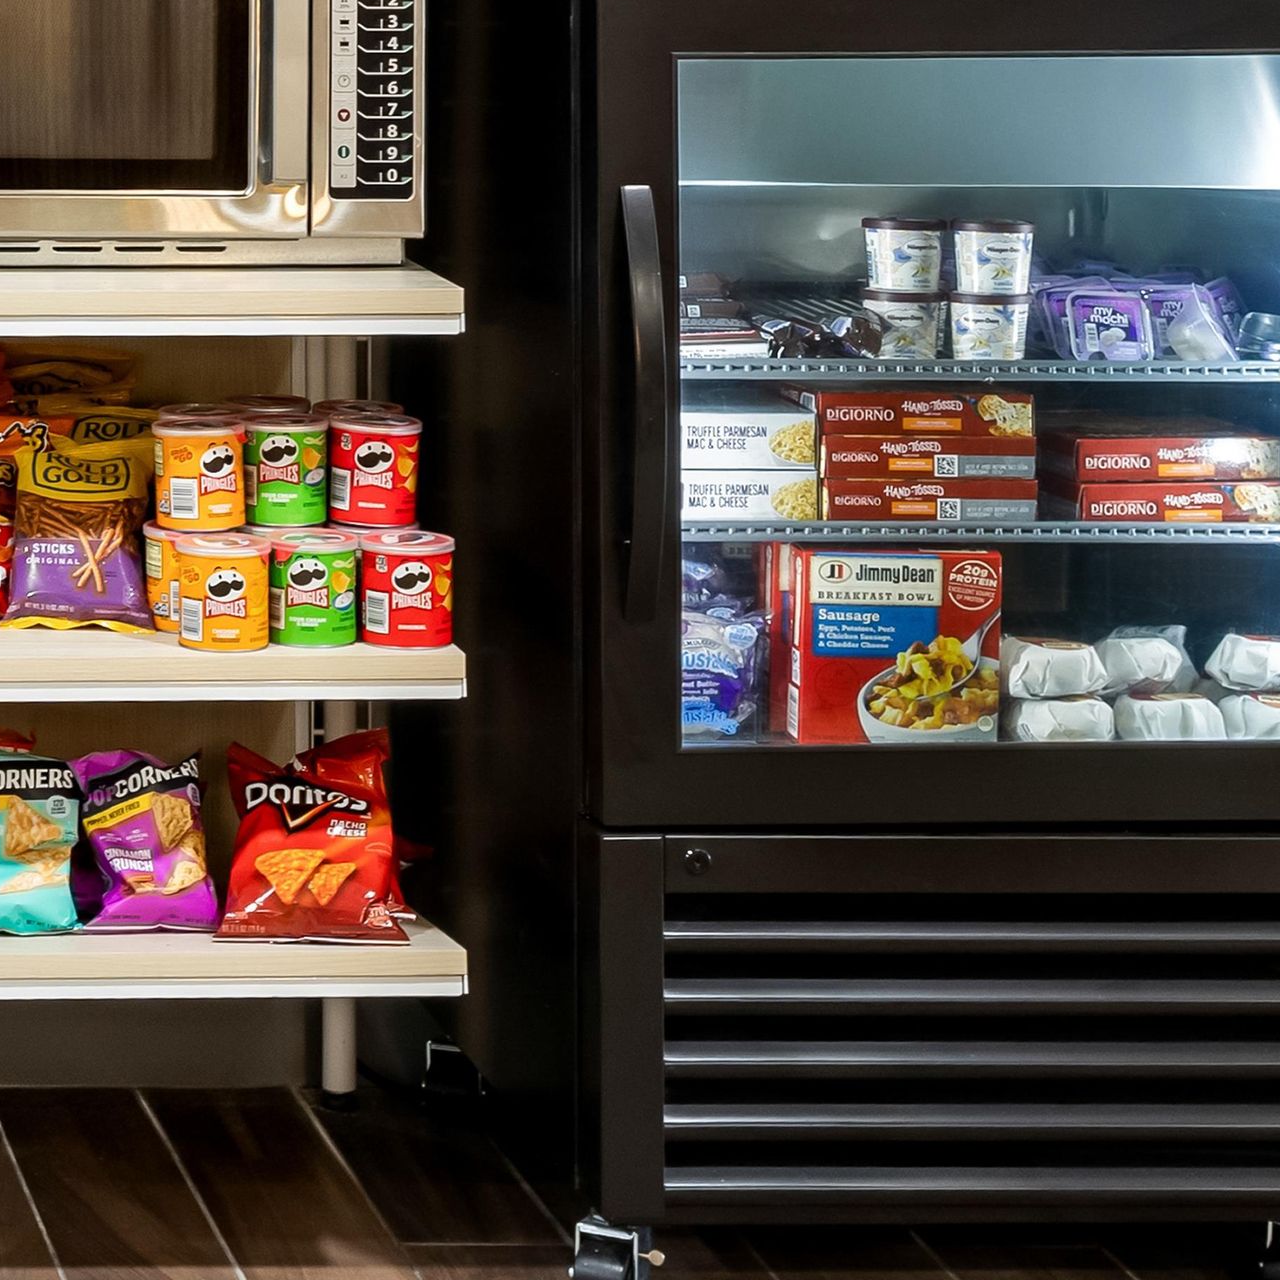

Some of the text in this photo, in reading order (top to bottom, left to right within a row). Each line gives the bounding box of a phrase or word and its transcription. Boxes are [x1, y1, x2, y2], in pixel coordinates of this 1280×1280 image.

[687, 425, 768, 438] TRUFFLE PARMESAN
[687, 438, 747, 450] MAC & CHEESE
[43, 467, 120, 486] GOLD
[259, 464, 300, 485] PRINGLES
[353, 471, 394, 490] PRINGLES
[200, 474, 236, 495] PRINGLES
[689, 484, 769, 496] TRUFFLE PARMESAN
[689, 496, 750, 508] MAC & CHEESE
[33, 543, 74, 554] STICKS
[26, 557, 80, 566] ORIGINAL
[855, 564, 935, 584] Jimmy Dean
[949, 573, 998, 588] PROTEIN
[287, 587, 329, 608] PRINGLES
[391, 592, 432, 611] PRINGLES
[818, 590, 892, 601] BREAKFAST
[898, 590, 935, 601] BOWL
[205, 598, 247, 618] PRINGLES
[818, 608, 880, 623] Sausage
[826, 632, 858, 641] Chicken
[826, 641, 889, 649] Cheddar Cheese
[330, 819, 367, 830] NACHO
